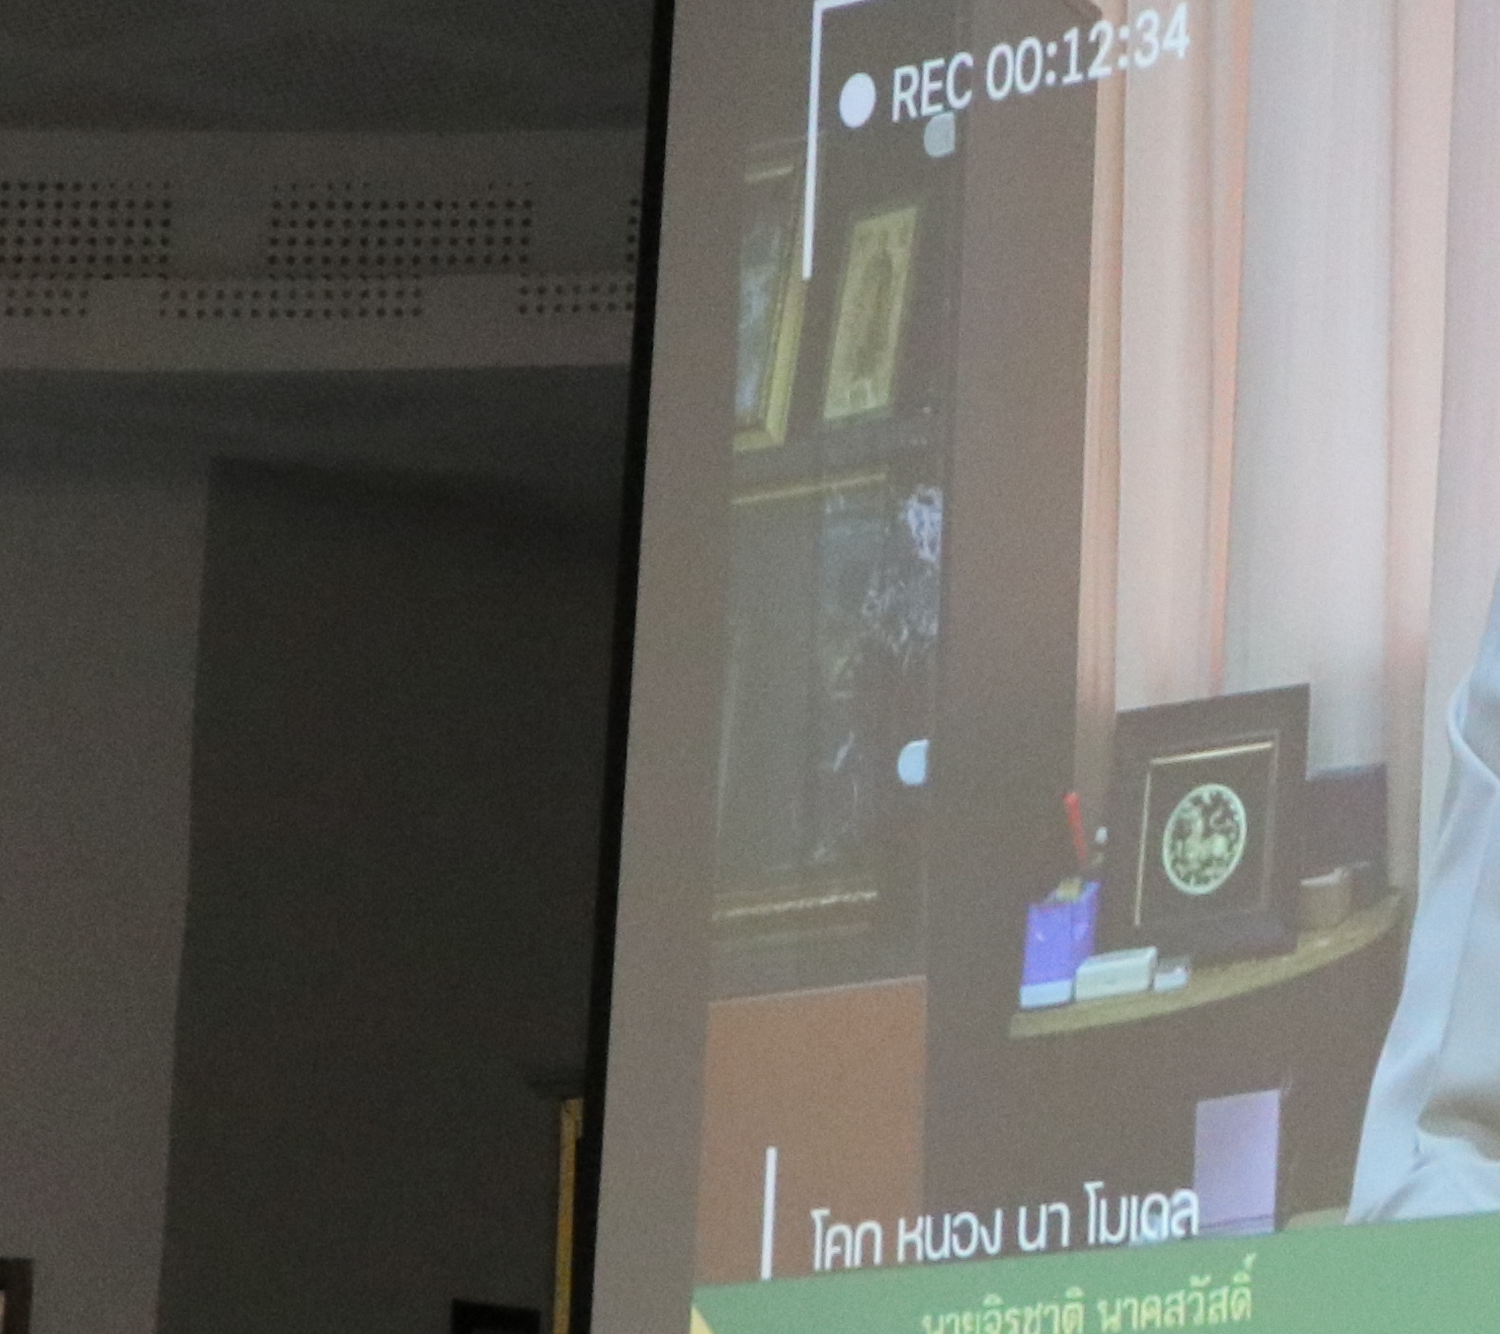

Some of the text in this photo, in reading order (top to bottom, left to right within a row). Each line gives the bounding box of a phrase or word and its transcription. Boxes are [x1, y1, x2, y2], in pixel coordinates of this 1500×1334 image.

[891, 1, 1191, 123] REC 00:12:34
[810, 1181, 1201, 1272] โคก หนอง นา โมเดล
